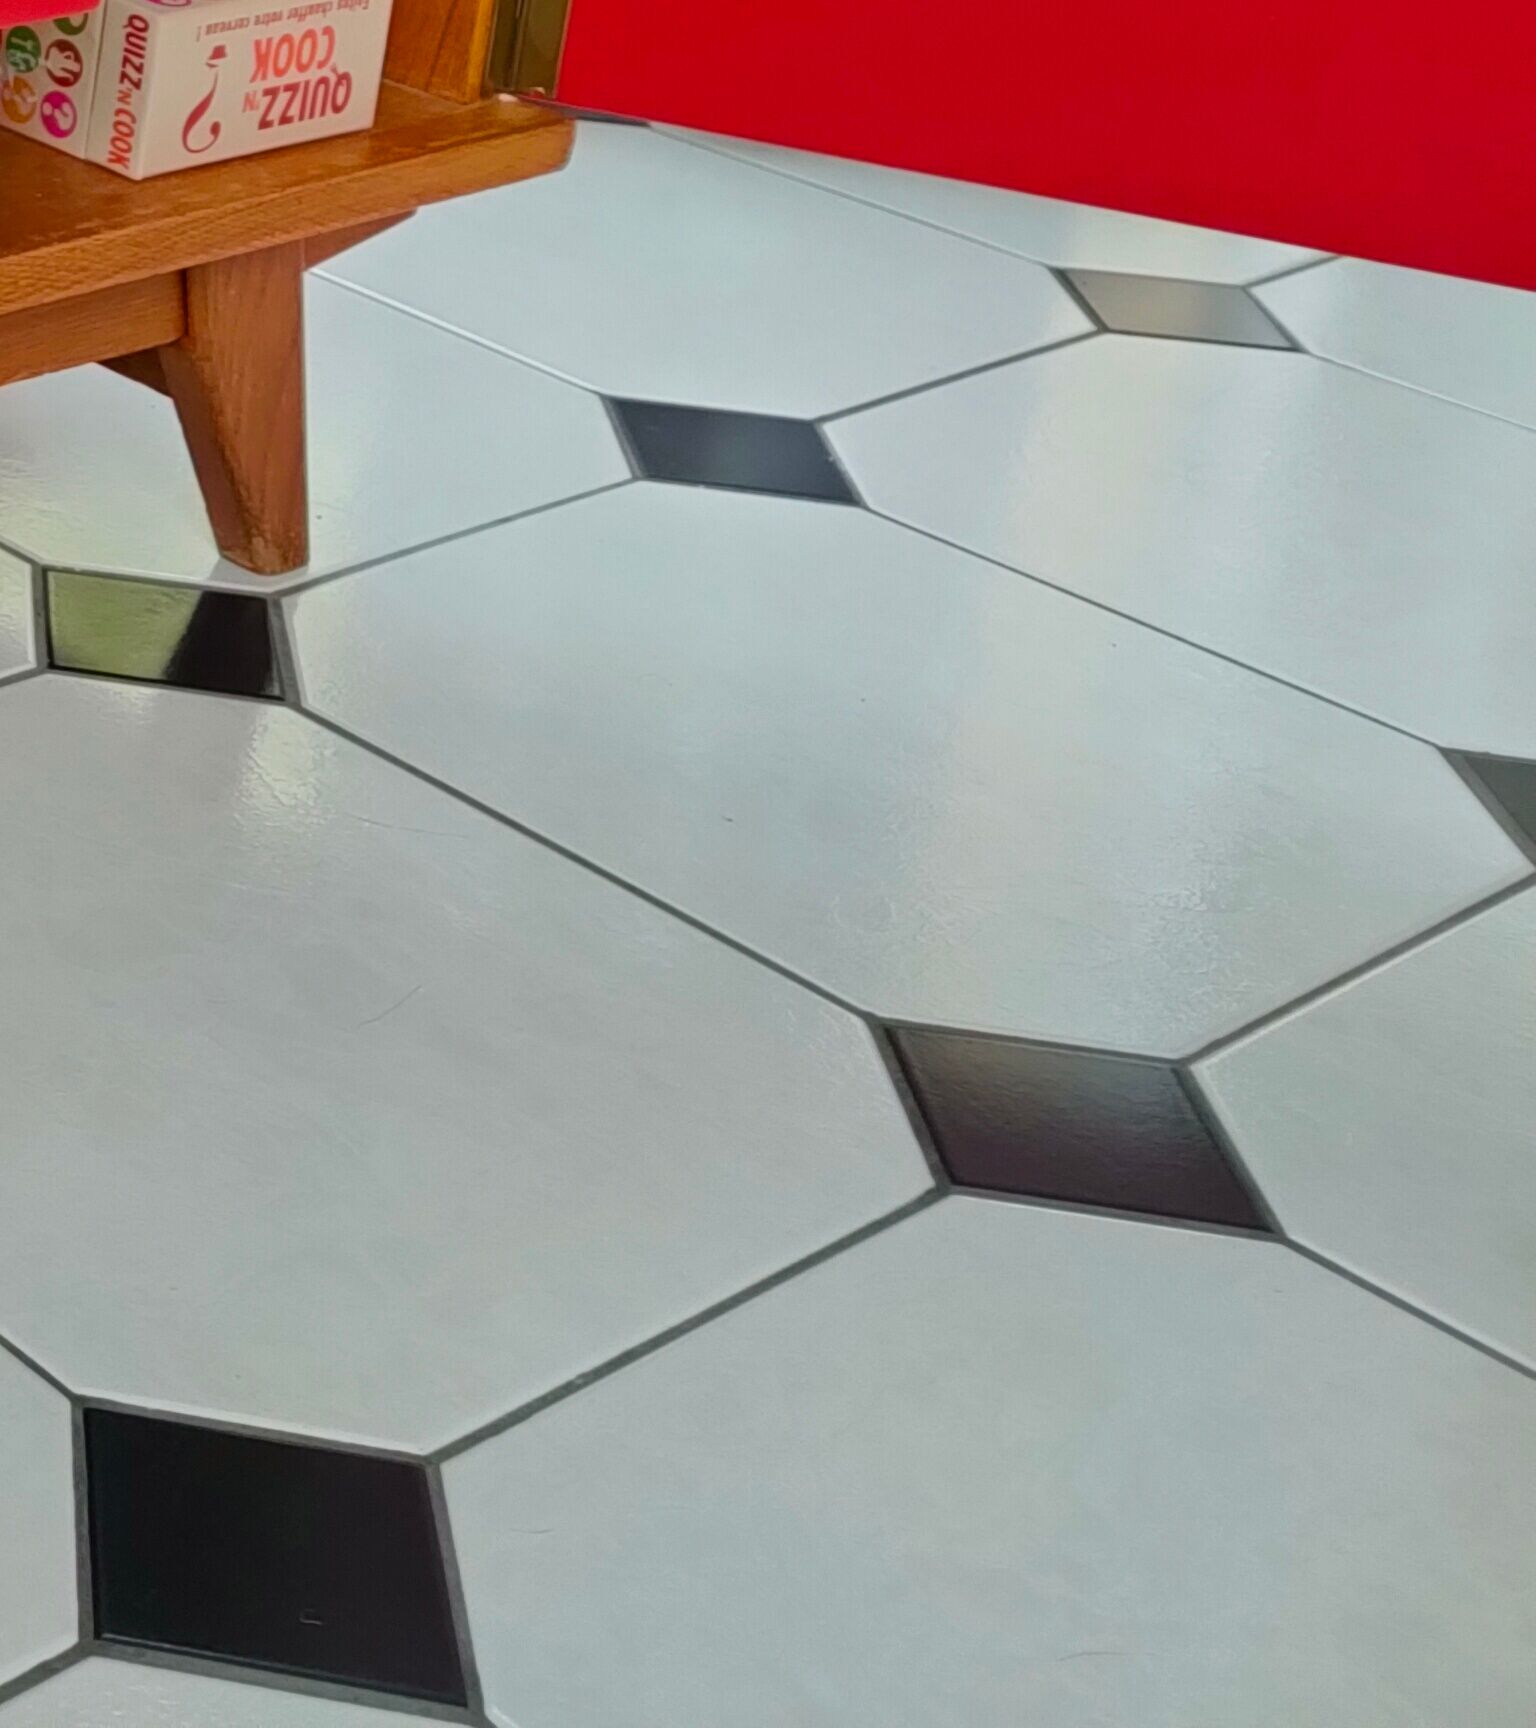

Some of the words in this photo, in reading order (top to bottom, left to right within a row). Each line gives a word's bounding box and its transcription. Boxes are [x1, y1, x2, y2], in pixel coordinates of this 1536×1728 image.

[287, 0, 333, 22] chauffer
[119, 13, 150, 92] QUIZZ
[250, 25, 336, 83] COOK
[257, 63, 353, 130] QUIZZ
[107, 107, 137, 170] COOK
